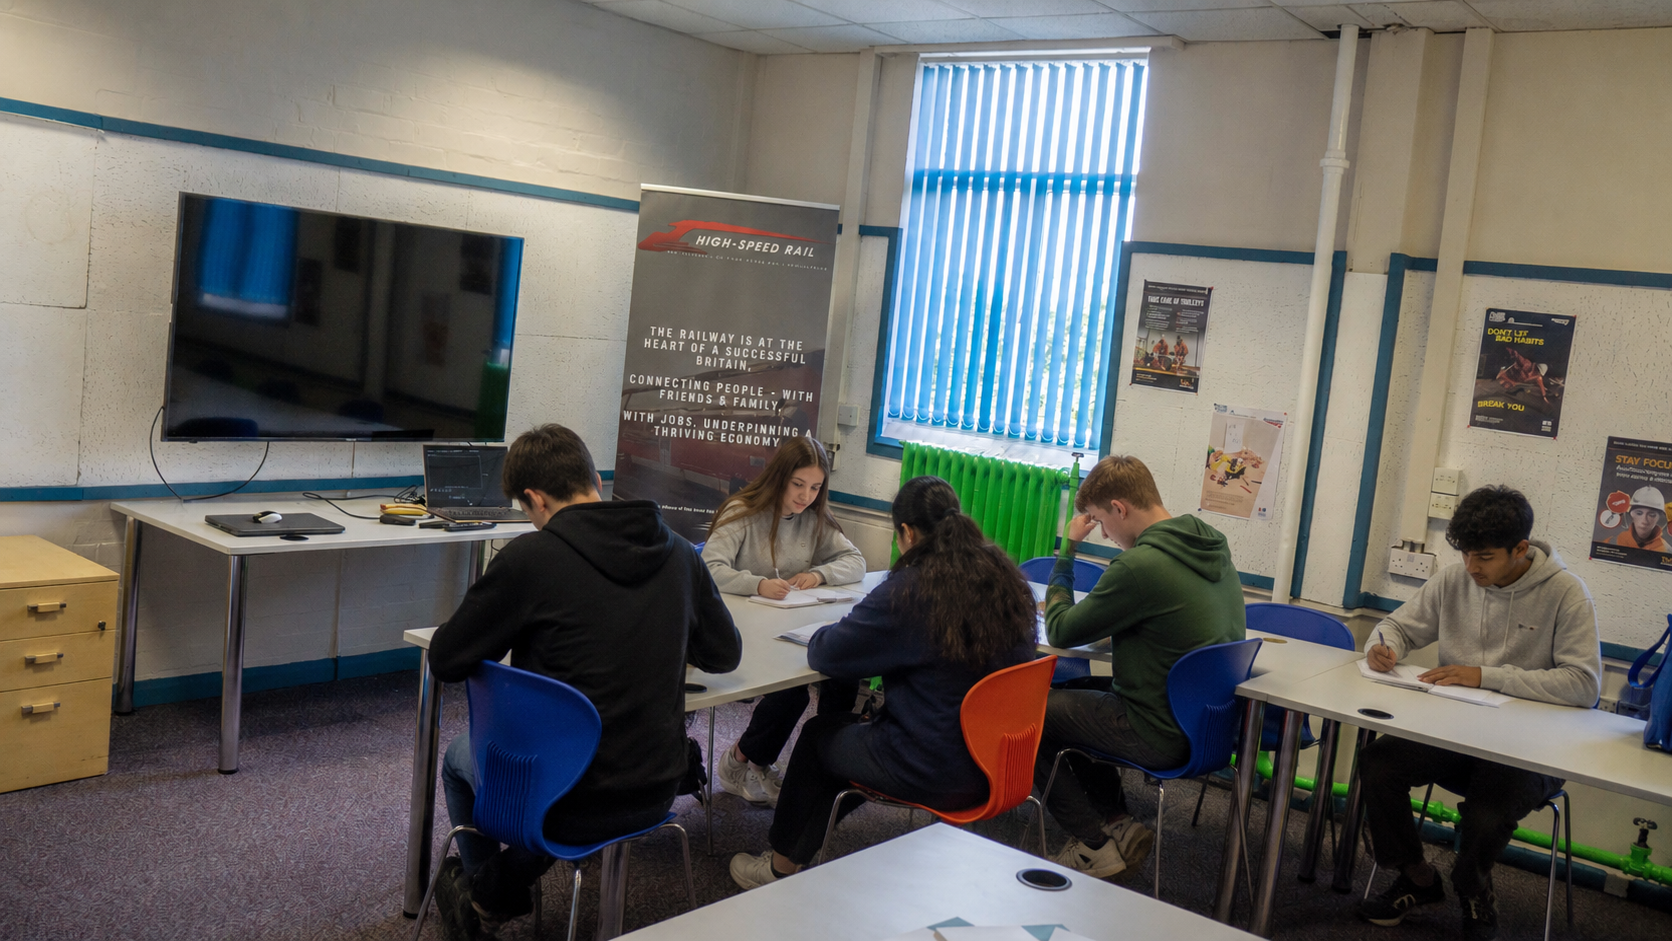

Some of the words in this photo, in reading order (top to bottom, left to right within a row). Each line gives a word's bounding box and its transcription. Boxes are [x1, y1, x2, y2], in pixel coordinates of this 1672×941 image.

[696, 235, 780, 254] HIGH-SPEED
[784, 245, 814, 258] RAIL
[650, 326, 673, 338] THE
[679, 329, 735, 344] RAILWAY
[740, 335, 752, 346] IS
[758, 337, 774, 348] AT
[780, 339, 803, 351] THE
[1514, 337, 1544, 346] HABITS
[644, 338, 685, 352] HEART
[691, 342, 705, 353] OF
[712, 345, 719, 355] A
[725, 346, 806, 364] SUCCESSFUL
[629, 374, 710, 391] CONNECTING
[716, 382, 764, 397] PEOPLE
[782, 389, 813, 402] WITH
[659, 389, 713, 405] FRIENDS
[719, 396, 726, 406] &
[1477, 400, 1505, 409] BREAK
[1507, 402, 1525, 412] YOU
[623, 410, 654, 424] WITH
[703, 418, 799, 437] UNDERPINNING
[805, 429, 812, 438] A
[654, 425, 715, 441] THRIVING
[720, 432, 780, 448] ECONOMY
[1615, 454, 1641, 465] STAY
[1643, 458, 1672, 470] FOCU
